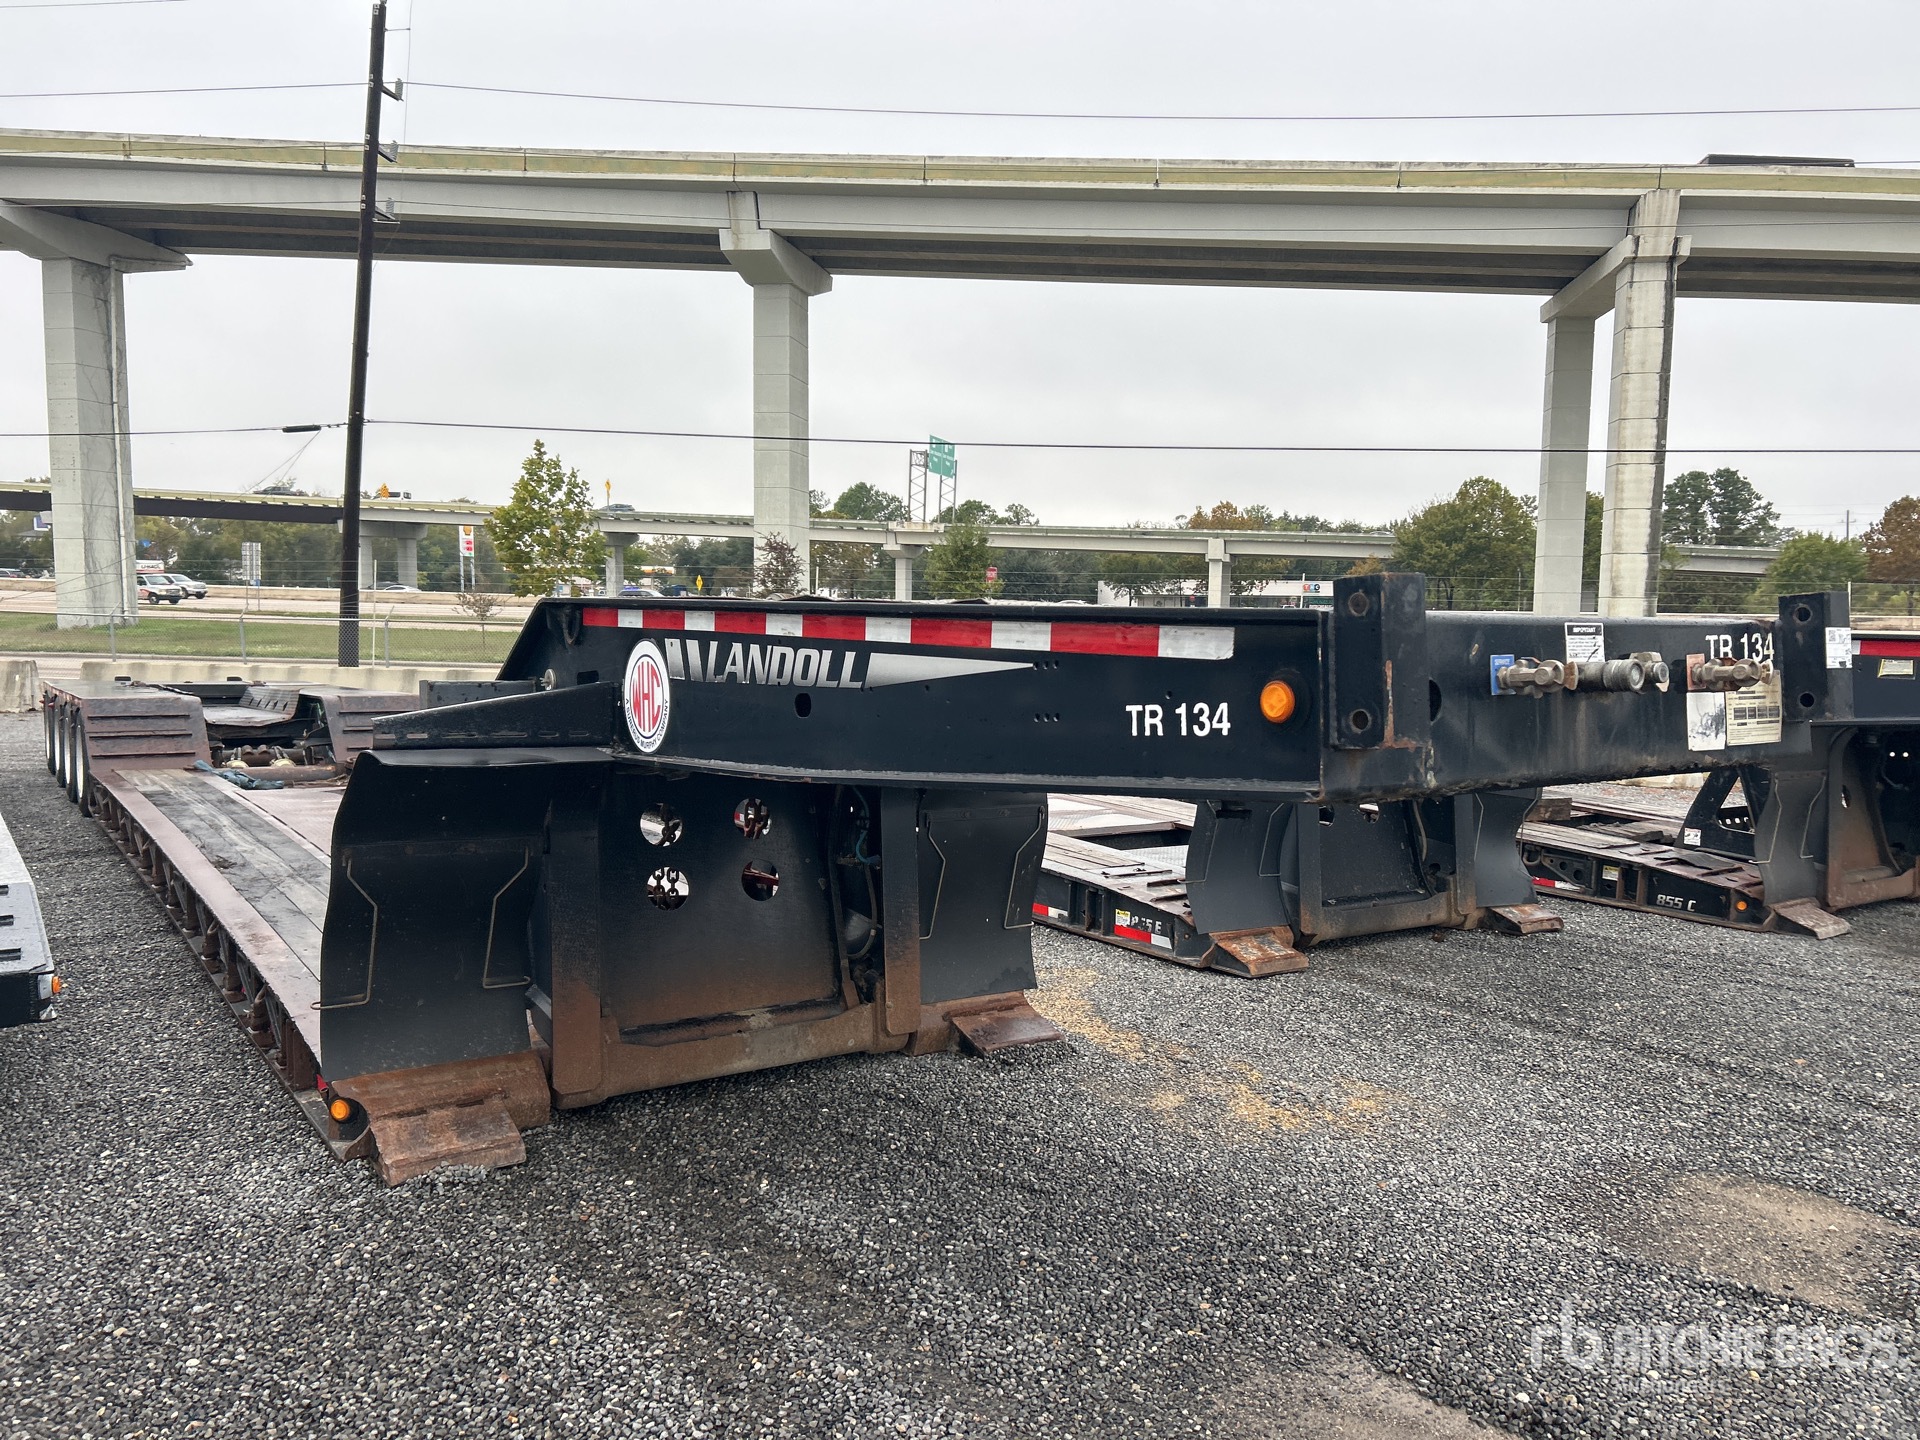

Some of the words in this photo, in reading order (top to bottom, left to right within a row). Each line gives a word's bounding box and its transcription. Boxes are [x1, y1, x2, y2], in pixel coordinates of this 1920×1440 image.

[706, 640, 863, 689] LANDOLL
[1705, 634, 1733, 660] TR
[1740, 632, 1775, 662] 134
[632, 660, 661, 733] WHC
[1125, 704, 1164, 737] TR
[1174, 702, 1231, 737] 134
[1656, 894, 1684, 909] 855
[1687, 899, 1697, 912] C
